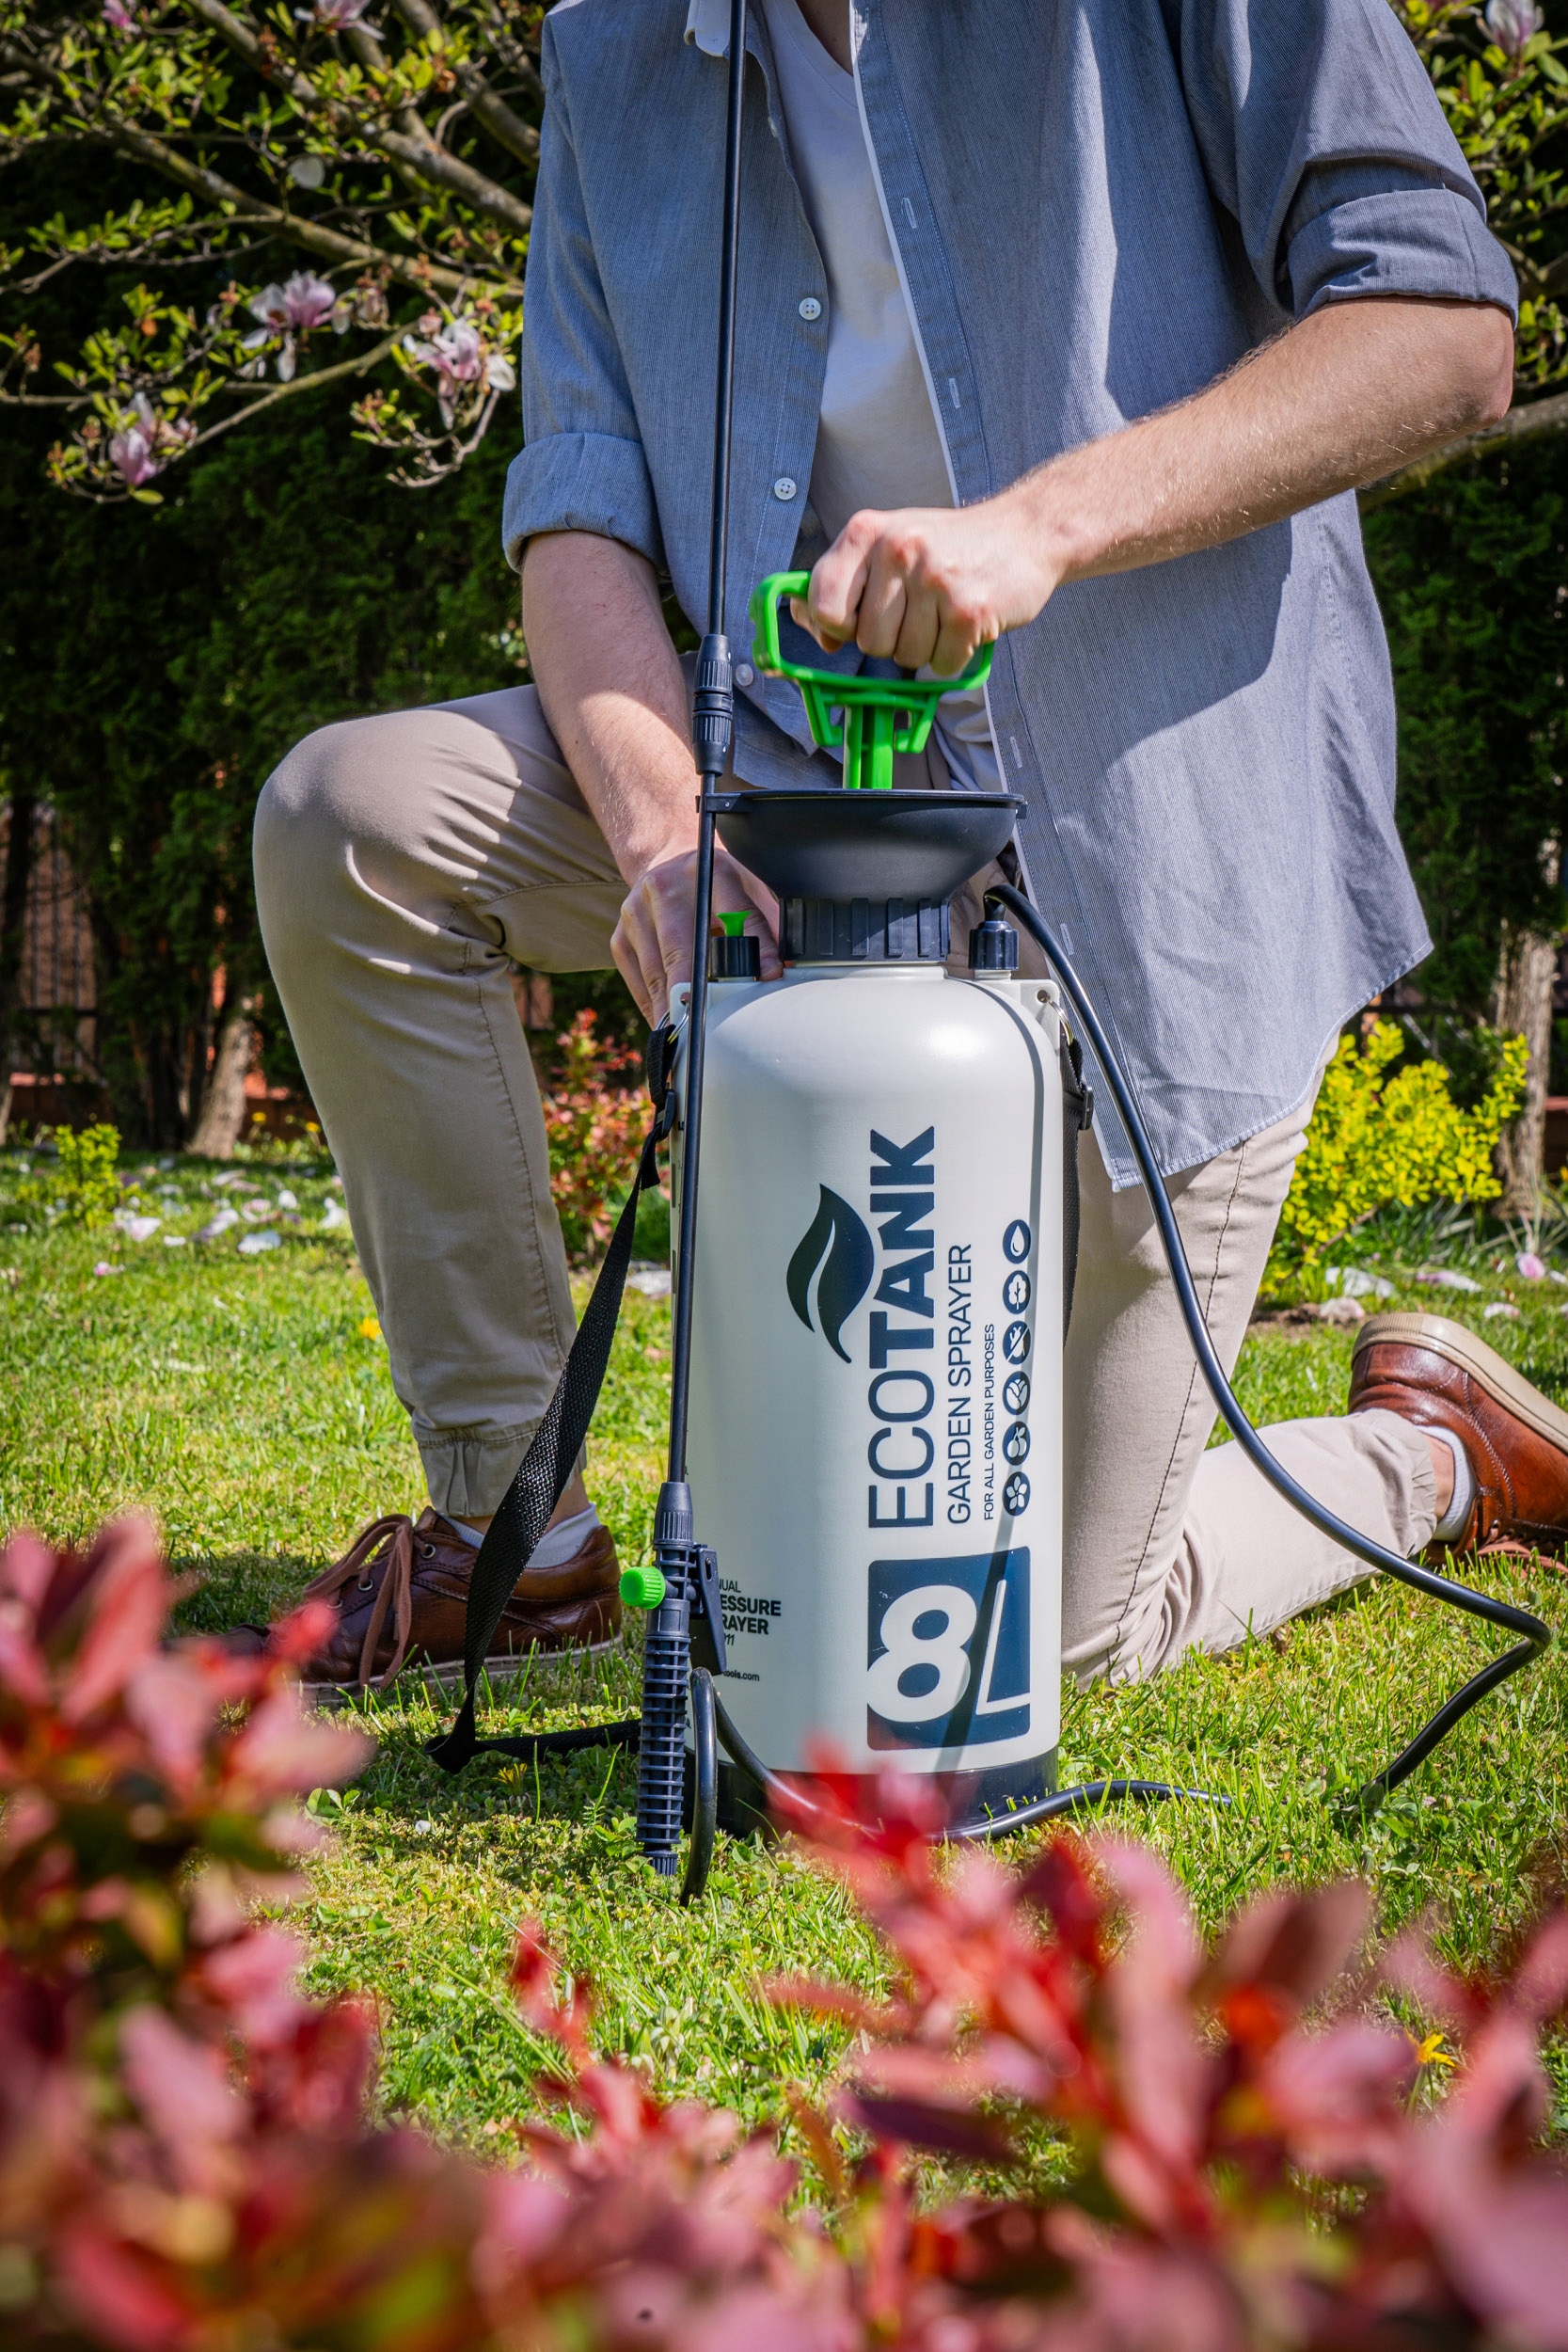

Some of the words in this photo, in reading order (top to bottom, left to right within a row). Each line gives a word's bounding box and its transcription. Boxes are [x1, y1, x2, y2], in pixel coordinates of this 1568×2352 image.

[868, 1125, 934, 1528] ECOTANK
[948, 1244, 972, 1387] SPRAYER
[984, 1324, 995, 1399] PURPOSES
[947, 1397, 972, 1524] GARDEN
[984, 1402, 994, 1460] GARDEN
[984, 1492, 994, 1520] FOR
[985, 1463, 994, 1488] ALL
[720, 1594, 782, 1616] ESSURE
[721, 1613, 769, 1635] RAYER
[867, 1579, 1030, 1723] 8L
